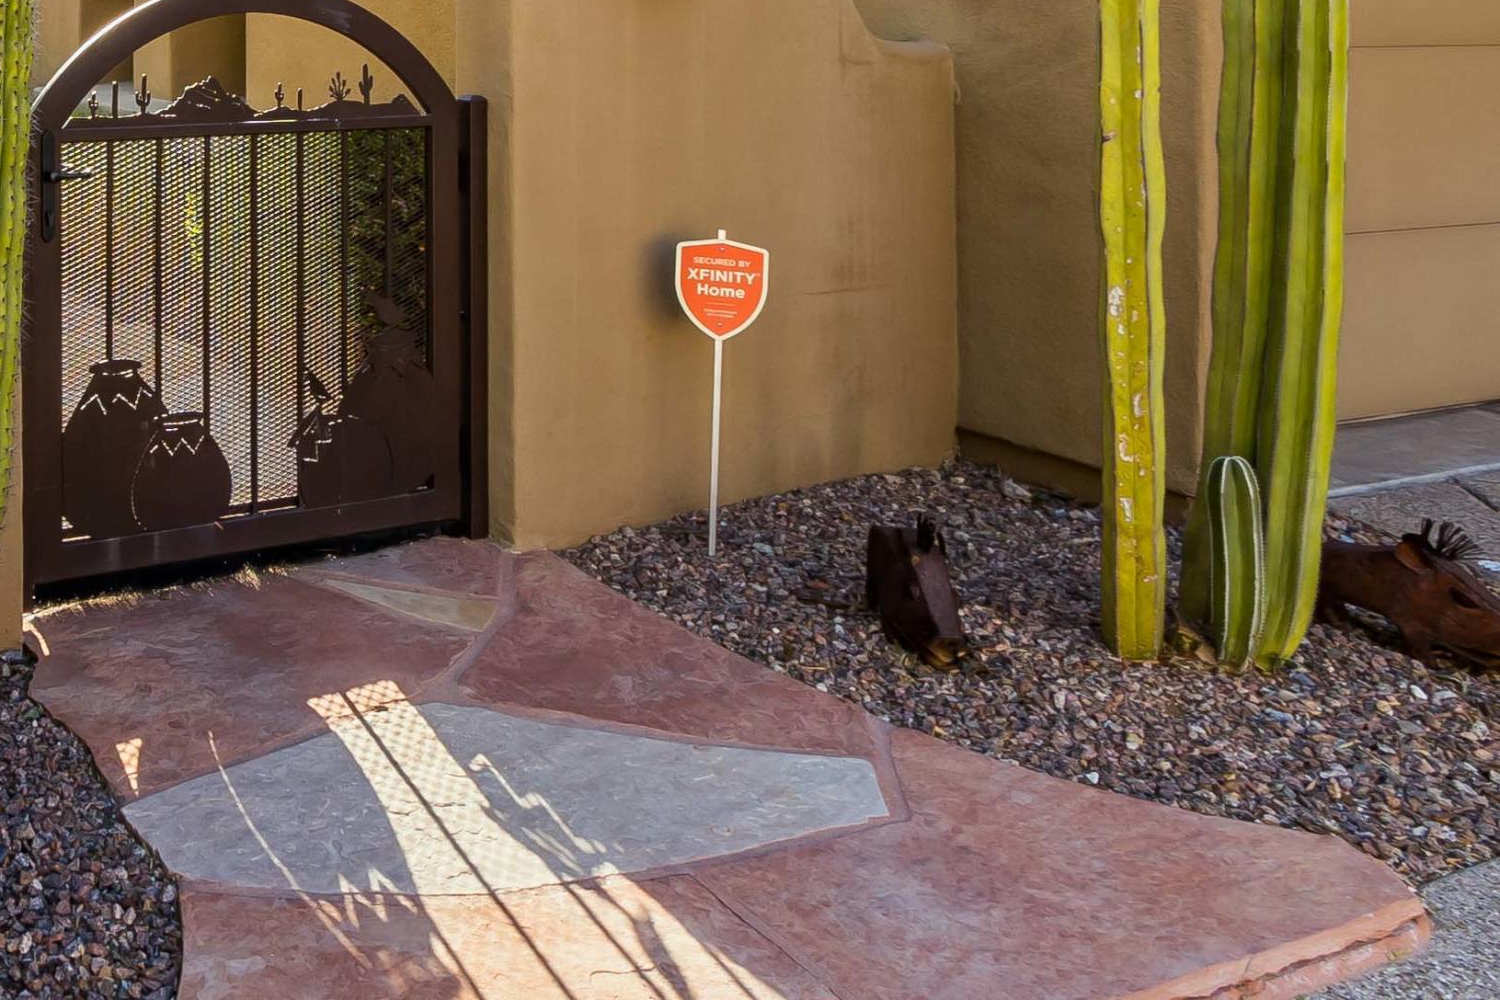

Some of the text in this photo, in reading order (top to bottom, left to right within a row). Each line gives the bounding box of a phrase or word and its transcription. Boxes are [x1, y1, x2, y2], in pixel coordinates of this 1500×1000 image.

[693, 256, 751, 268] SECURED BY
[687, 267, 757, 285] XFINITY
[697, 283, 745, 298] Home
